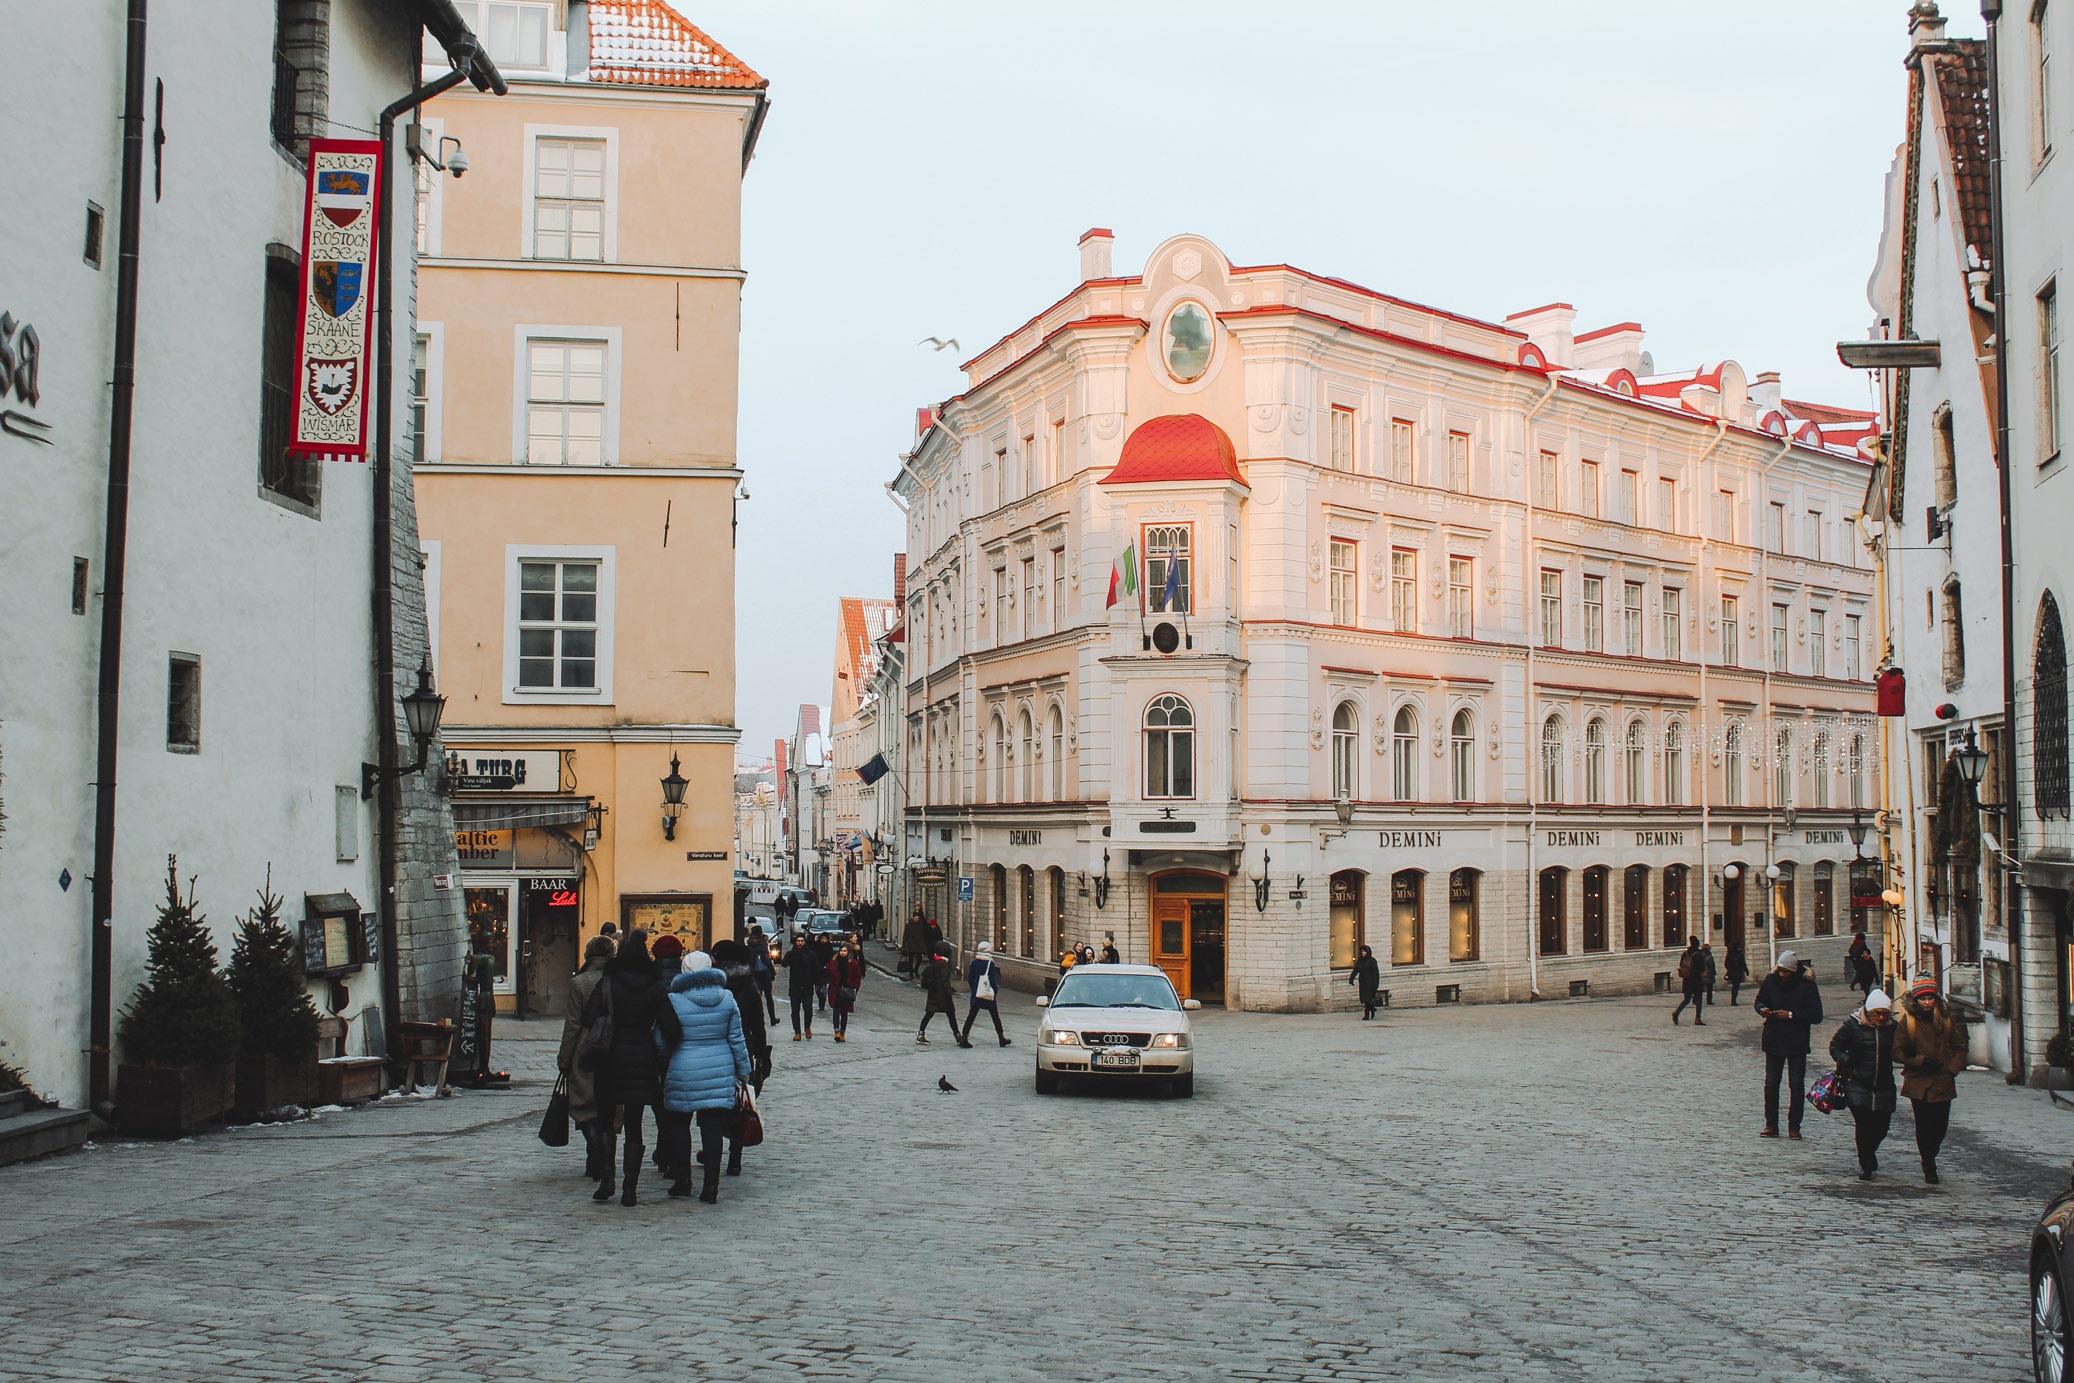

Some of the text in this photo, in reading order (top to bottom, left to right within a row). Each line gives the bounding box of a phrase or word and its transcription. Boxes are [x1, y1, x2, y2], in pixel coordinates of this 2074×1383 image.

[312, 230, 369, 248] ROSTOCK
[306, 320, 360, 338] SKAANE
[302, 417, 357, 432] WISMAR
[457, 831, 498, 846] altic
[1379, 830, 1441, 848] DEMINi
[1548, 831, 1600, 846] DEMINi
[1636, 831, 1683, 846] DEMINi
[459, 845, 499, 860] mber
[531, 879, 567, 890] BAAR
[961, 879, 970, 892] P
[1100, 1056, 1136, 1065] 140 BDB
